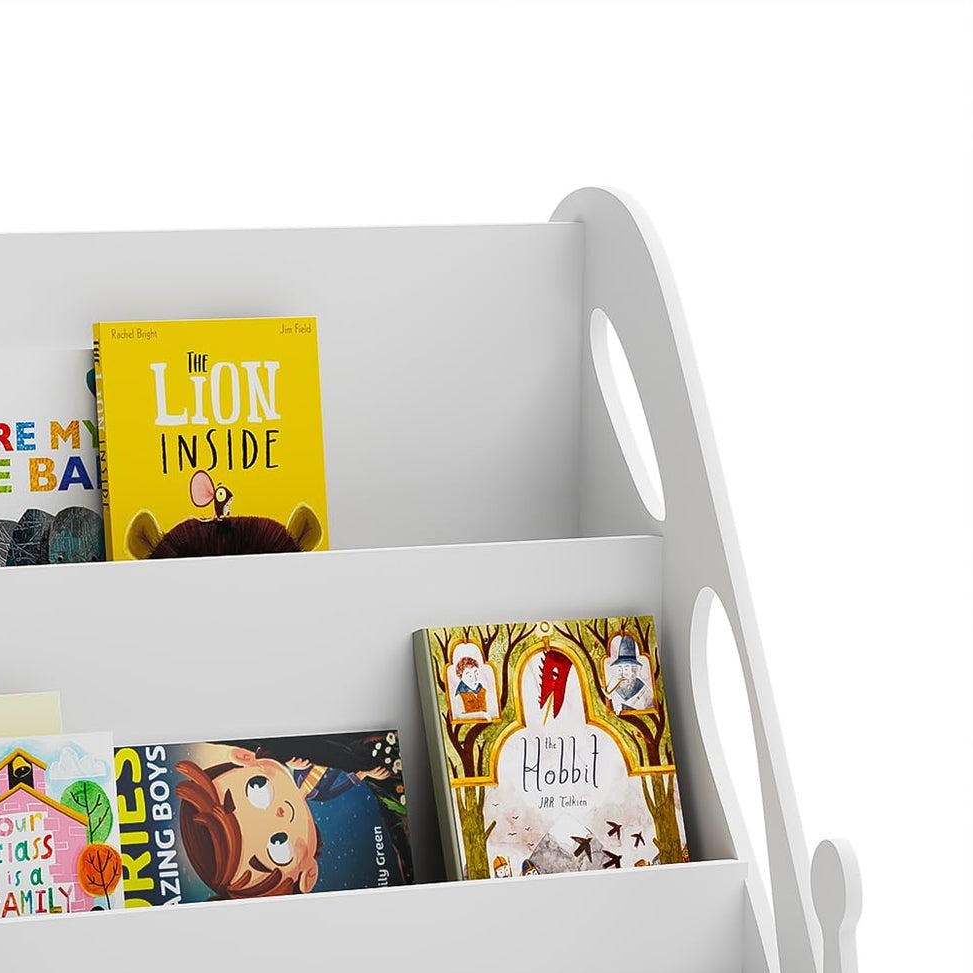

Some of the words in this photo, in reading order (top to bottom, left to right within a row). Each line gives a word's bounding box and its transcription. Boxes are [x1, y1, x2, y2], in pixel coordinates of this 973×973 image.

[111, 328, 134, 340] Rachel
[137, 328, 158, 340] Bright
[280, 324, 293, 335] Jim
[294, 323, 312, 334] Field
[187, 351, 209, 373] THE
[49, 419, 99, 450] MY
[161, 429, 280, 474] INSIDE
[29, 455, 102, 493] BA
[545, 737, 557, 750] the
[521, 733, 600, 792] Hobbit
[145, 745, 173, 821] BOYS
[559, 796, 588, 807] Tolkien
[373, 826, 386, 866] Green
[7, 870, 22, 886] is
[30, 867, 44, 886] a
